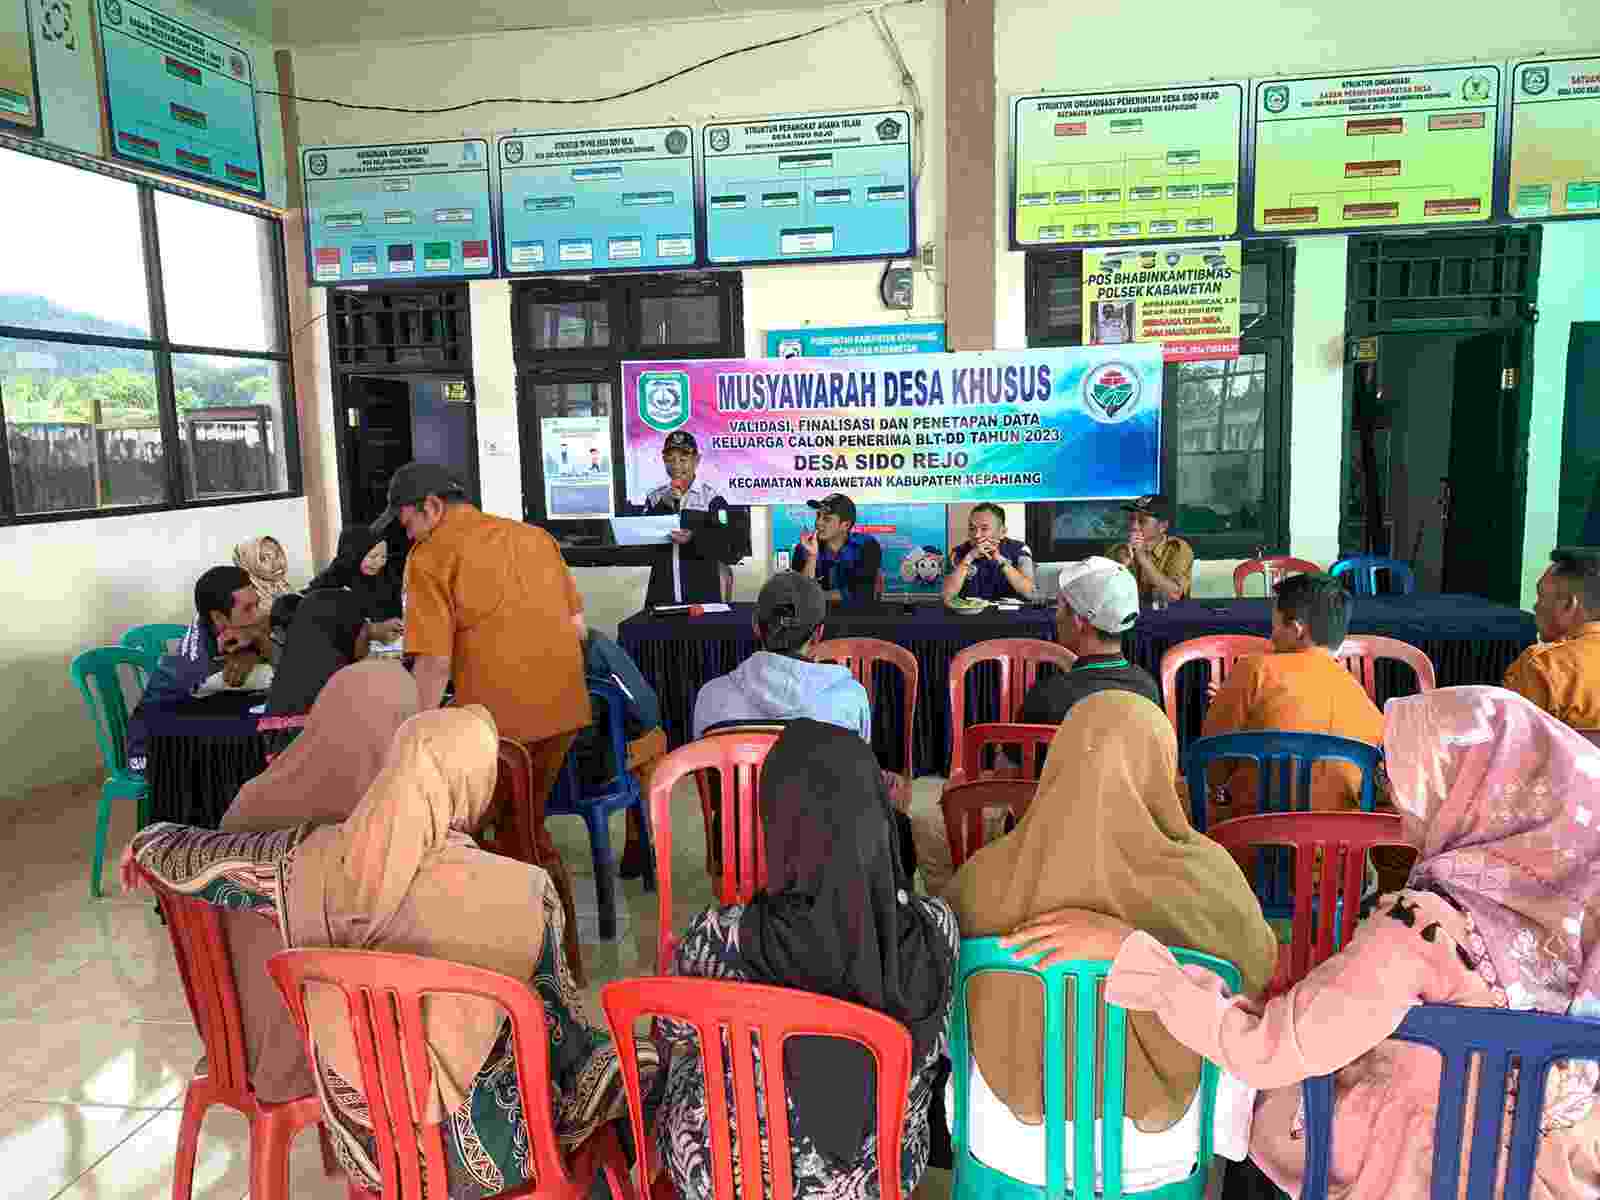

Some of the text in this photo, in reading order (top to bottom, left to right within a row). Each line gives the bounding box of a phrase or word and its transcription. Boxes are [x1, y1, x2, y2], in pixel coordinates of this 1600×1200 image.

[1162, 94, 1180, 104] DESA
[1088, 267, 1232, 286] POS BHABINKAMTIBMAS
[1097, 282, 1222, 299] POLSEK KABAWETAN
[718, 364, 1051, 410] MUSYAWARAH DESA KHUSUS
[729, 413, 1040, 434] VALIDASI, FINALISASI DAN PENETAPAN DATA
[712, 435, 784, 449] KELUARGA
[788, 434, 834, 448] CALON
[839, 433, 911, 447] PENERIMA
[916, 431, 965, 445] BLT-DD
[970, 430, 1020, 444] TAHUN
[794, 451, 969, 472] DESA SIDO REJO
[729, 472, 1041, 489] KECAMATAN KABAWETAN KABUPATEN KEPAHIANG
